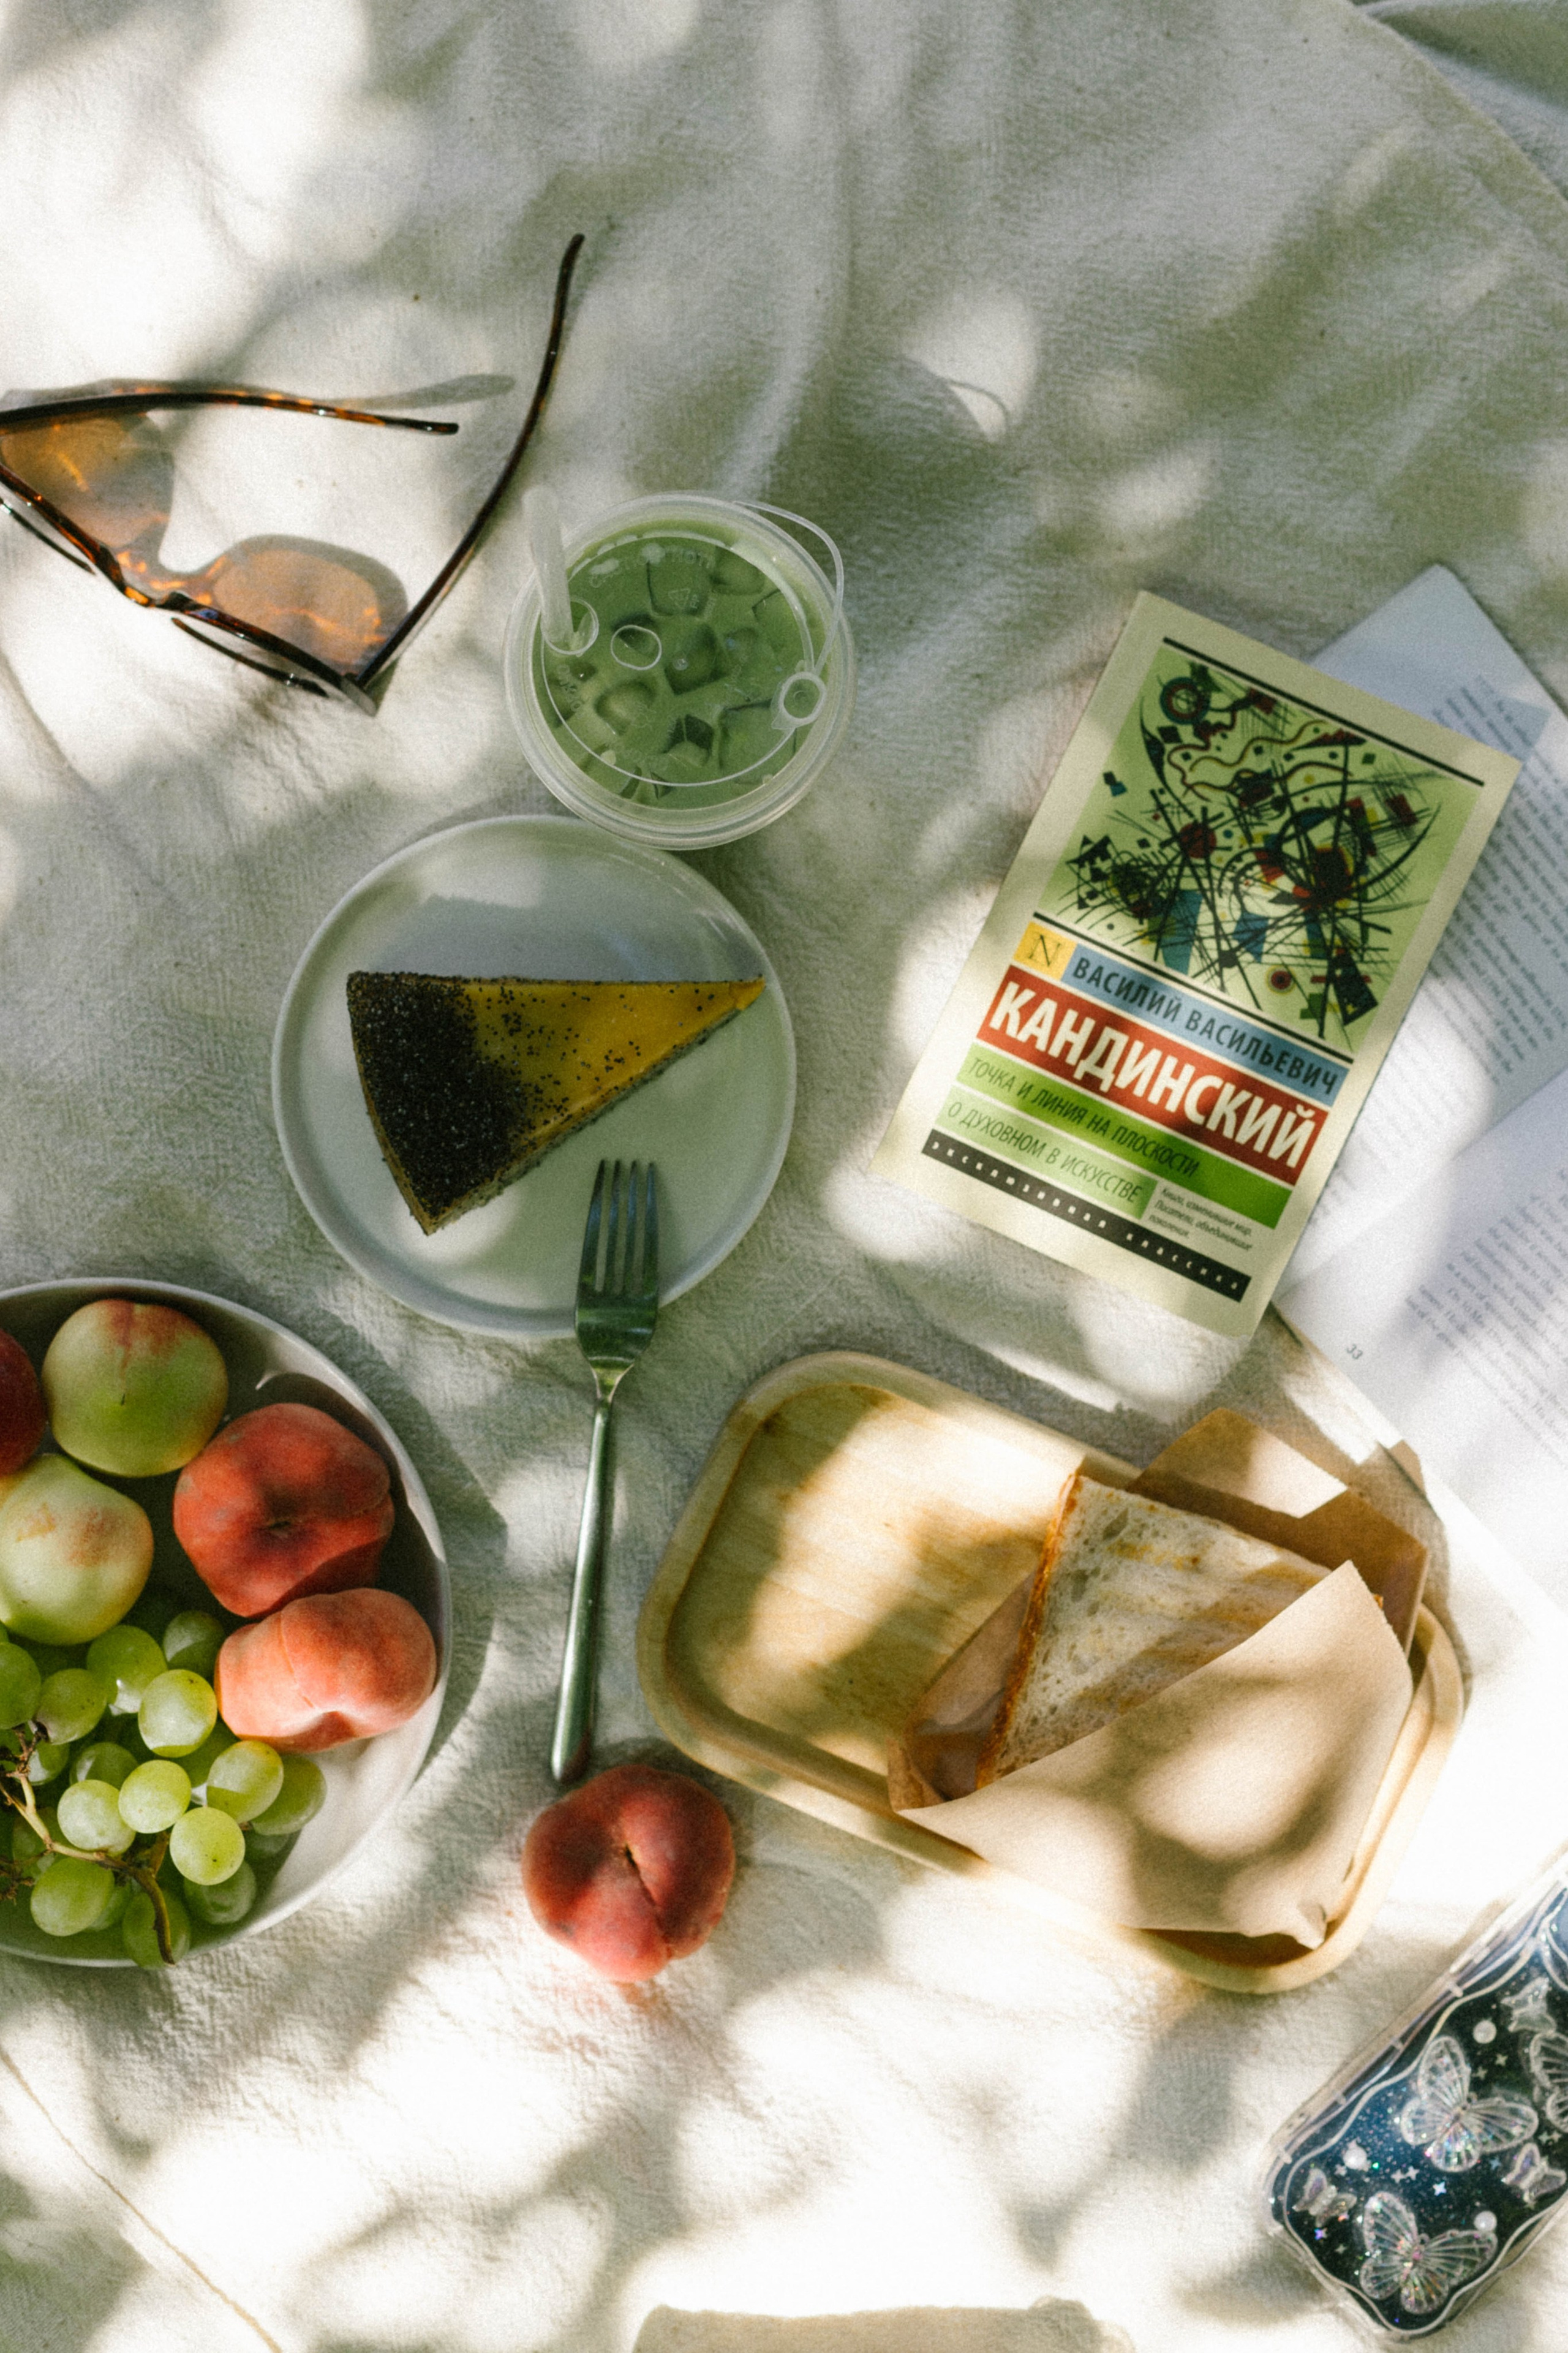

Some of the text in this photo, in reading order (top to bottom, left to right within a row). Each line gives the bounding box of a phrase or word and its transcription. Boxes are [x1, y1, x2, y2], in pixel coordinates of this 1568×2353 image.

[987, 981, 1316, 1168] КАНДИНСКИЙ
[1072, 956, 1338, 1095] ВАСИЛИЙ ВАСИЛЬЕВИЧ
[947, 1101, 1147, 1209] О ДУХОВНОМ В ИСКУССТВЕ
[969, 1057, 1200, 1178] ТОЧКА И ЛИНИЯ НА ПЛОСКОСТИ
[1346, 1343, 1363, 1360] 33
